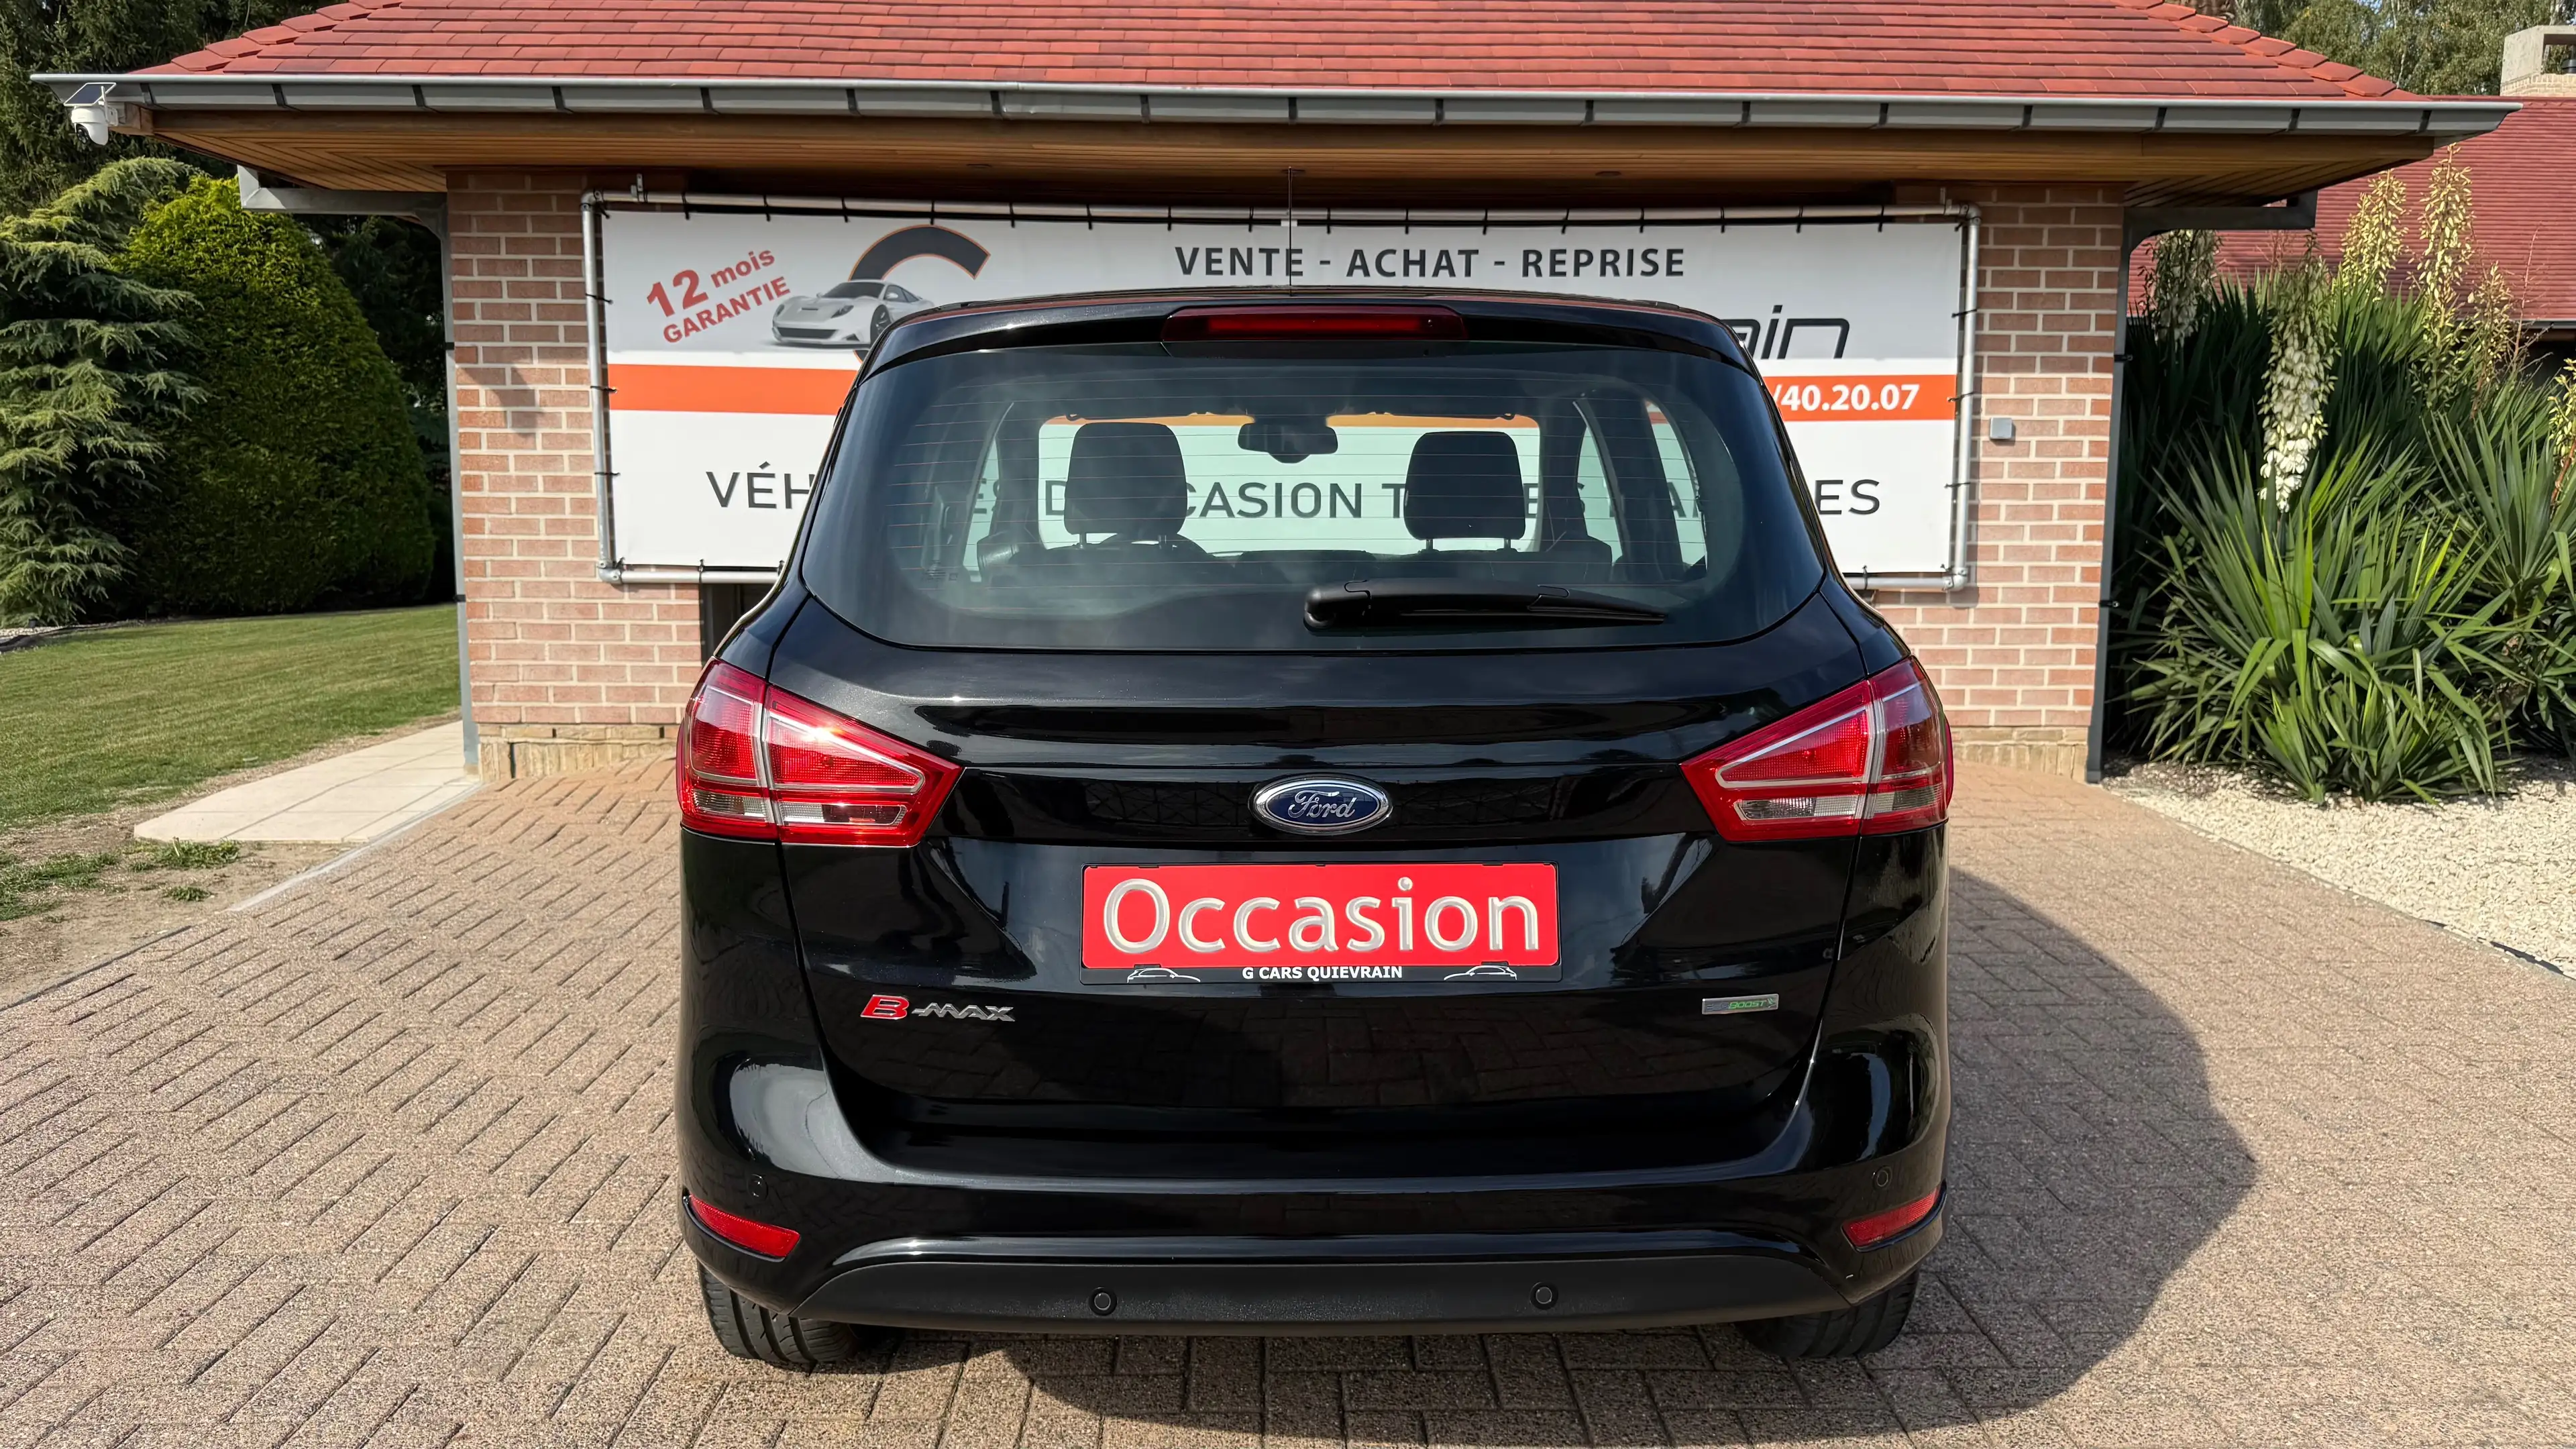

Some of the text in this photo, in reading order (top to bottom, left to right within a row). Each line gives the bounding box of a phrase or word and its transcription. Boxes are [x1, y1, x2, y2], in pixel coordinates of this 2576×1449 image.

[1175, 246, 1303, 277] VENTE
[1346, 248, 1479, 278] ACHAT
[1521, 248, 1684, 278] REPRISE
[646, 250, 775, 318] 12 mois
[663, 276, 791, 343] GARANTIE
[1287, 789, 1358, 818] Ford
[1103, 877, 1540, 955] Occasion
[1242, 965, 1403, 981] G CARS QUIEVRAIN
[860, 994, 1016, 1023] B-MAX
